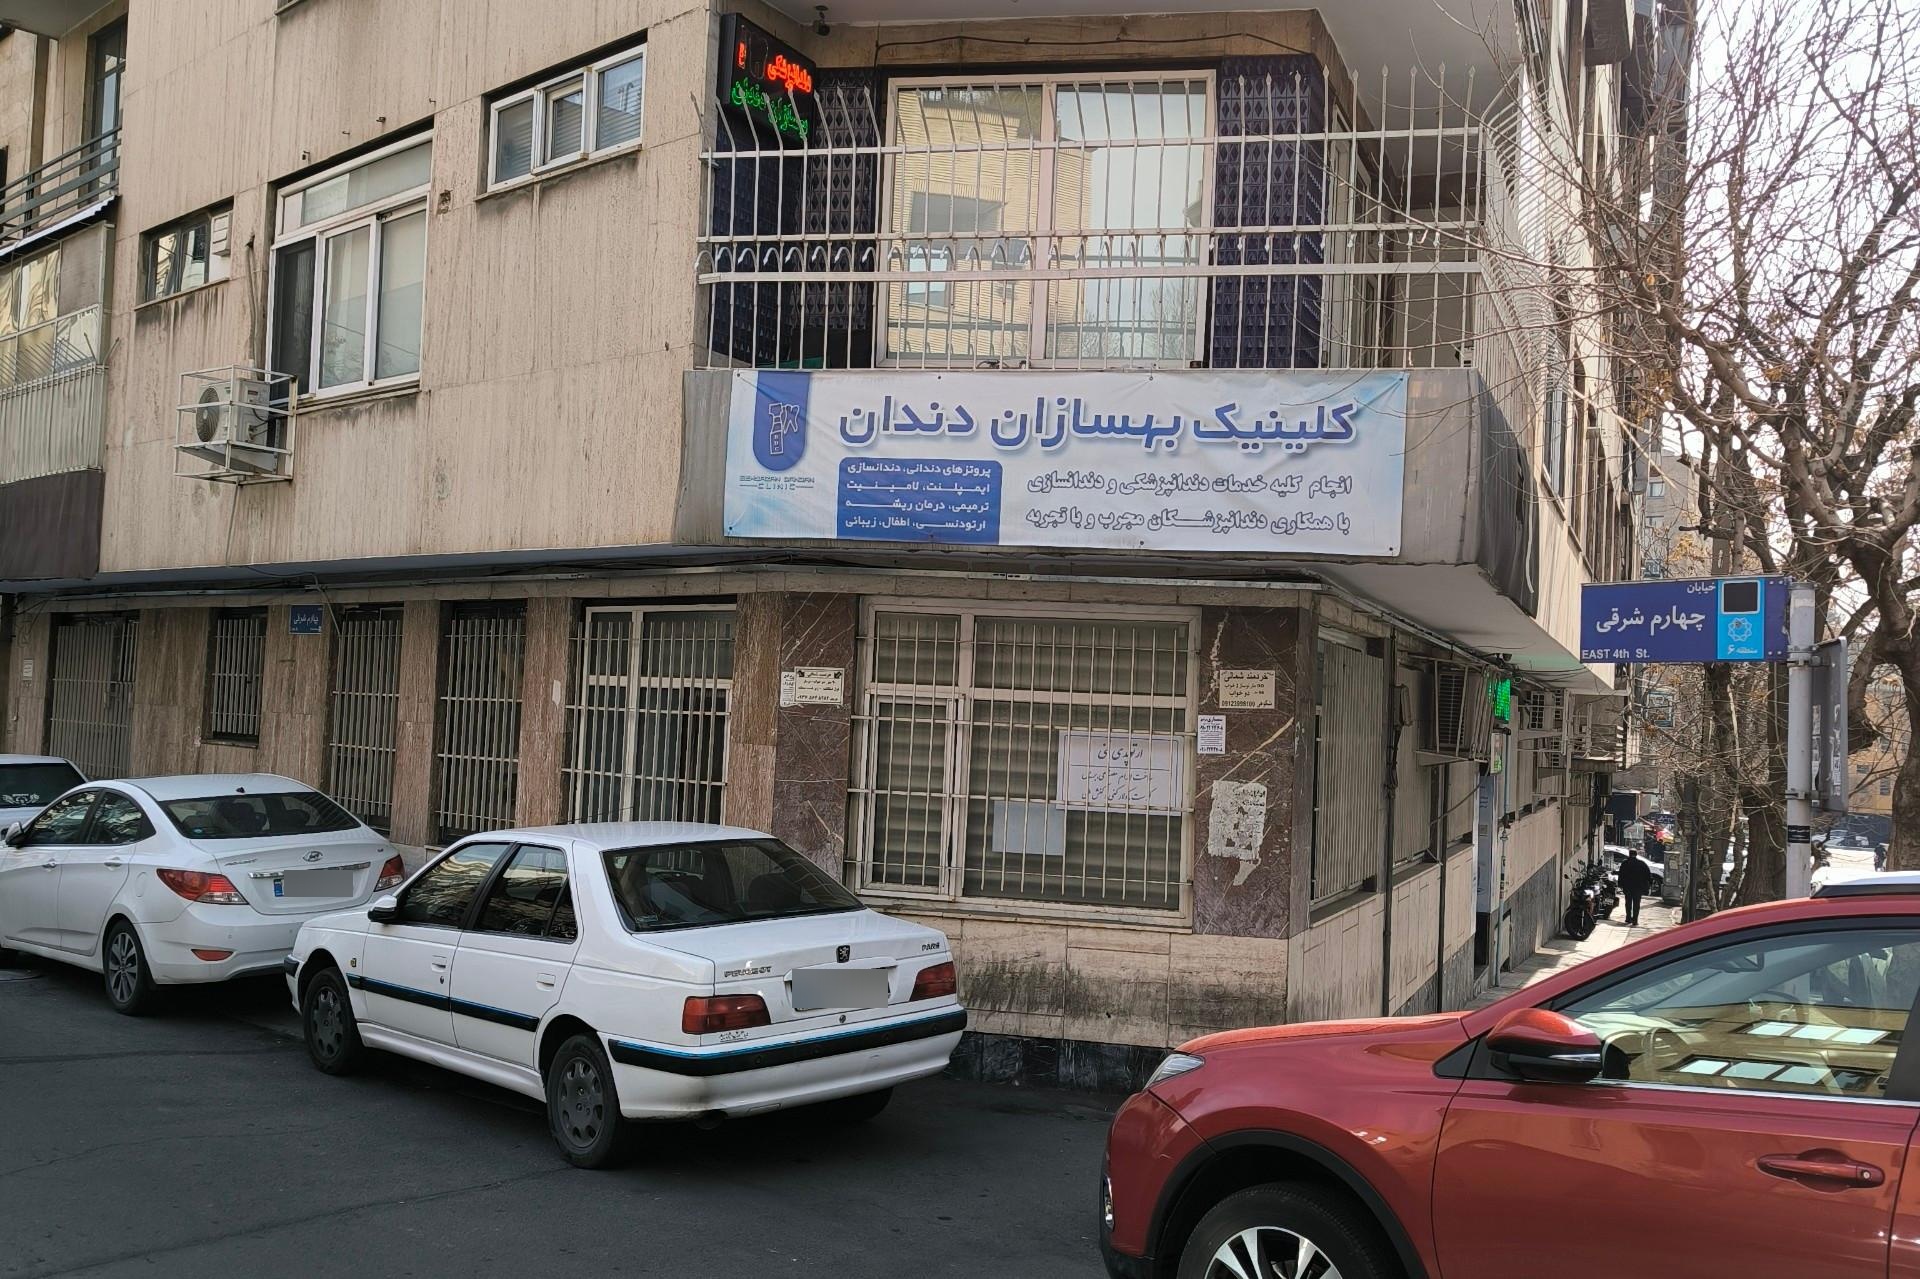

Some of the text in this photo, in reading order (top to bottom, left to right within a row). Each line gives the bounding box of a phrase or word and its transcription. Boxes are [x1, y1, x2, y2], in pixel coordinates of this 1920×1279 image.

[839, 395, 1355, 450] کلینیک بهسازان دندان
[847, 462, 901, 475] دندانسازی
[943, 463, 991, 478] پروتزهای
[757, 483, 796, 491] CLINIC
[1027, 470, 1352, 498] انجام کلیه خدمات دندانپزشکی و دندانسازی
[845, 497, 912, 512] ریشه
[915, 499, 946, 511] درمان
[1026, 507, 1350, 535] با همکاری دندانپزشکان مجرب و با تجربه
[1686, 581, 1716, 594] خیابان
[1596, 605, 1706, 637] چهارم شرقی
[1581, 648, 1650, 660] EAST 4th St.
[724, 966, 772, 978] PEUGEOT
